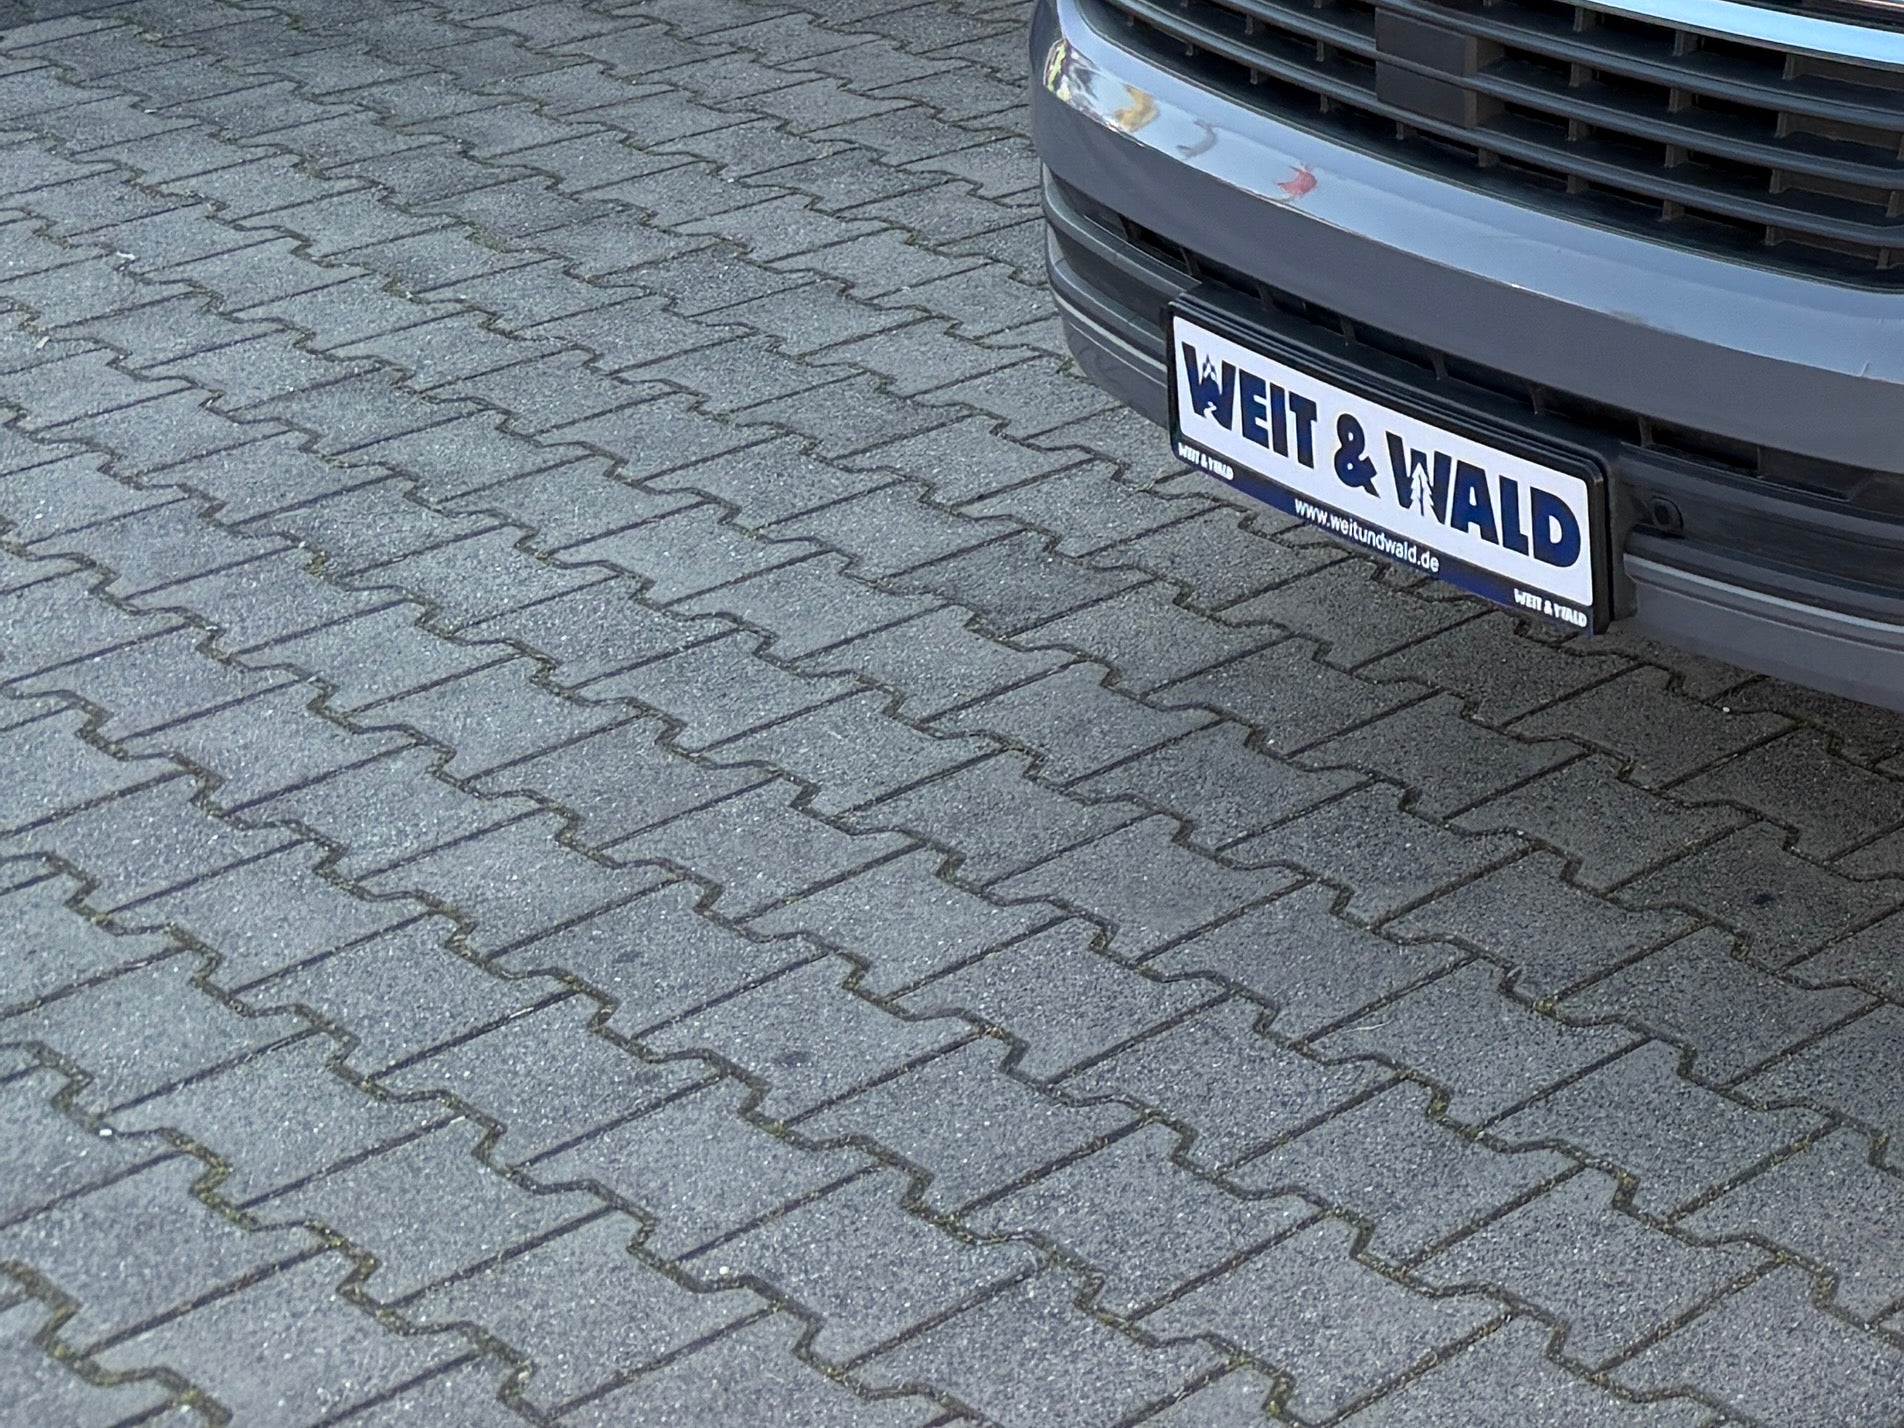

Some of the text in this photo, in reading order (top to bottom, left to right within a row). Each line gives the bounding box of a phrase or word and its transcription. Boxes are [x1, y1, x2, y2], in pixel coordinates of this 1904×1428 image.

[1181, 340, 1582, 568] WEIT & WALD
[1294, 498, 1440, 573] www.weitundwald.de
